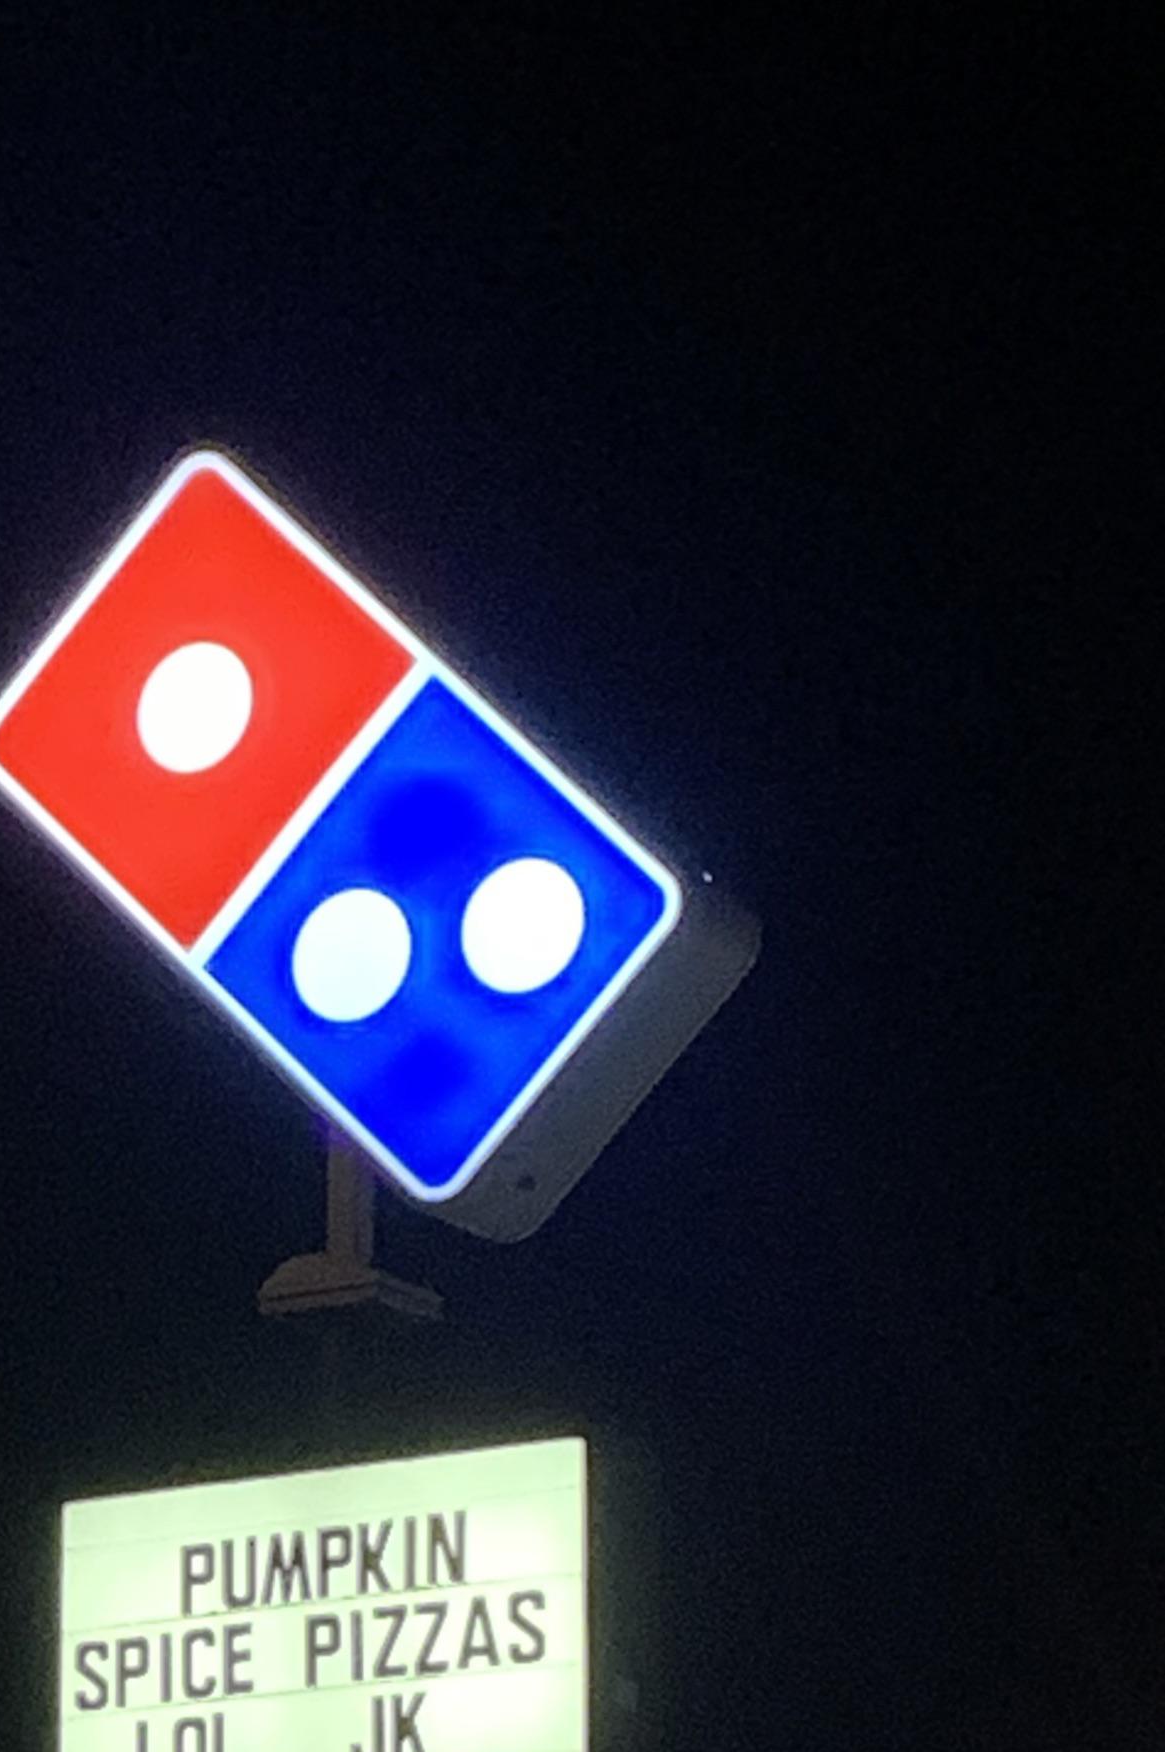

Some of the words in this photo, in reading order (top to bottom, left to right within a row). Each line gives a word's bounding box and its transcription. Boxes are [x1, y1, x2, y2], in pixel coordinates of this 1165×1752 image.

[180, 1510, 466, 1616] PUMPKIN
[74, 1623, 254, 1711] SPICE
[305, 1590, 546, 1687] PIZZAS
